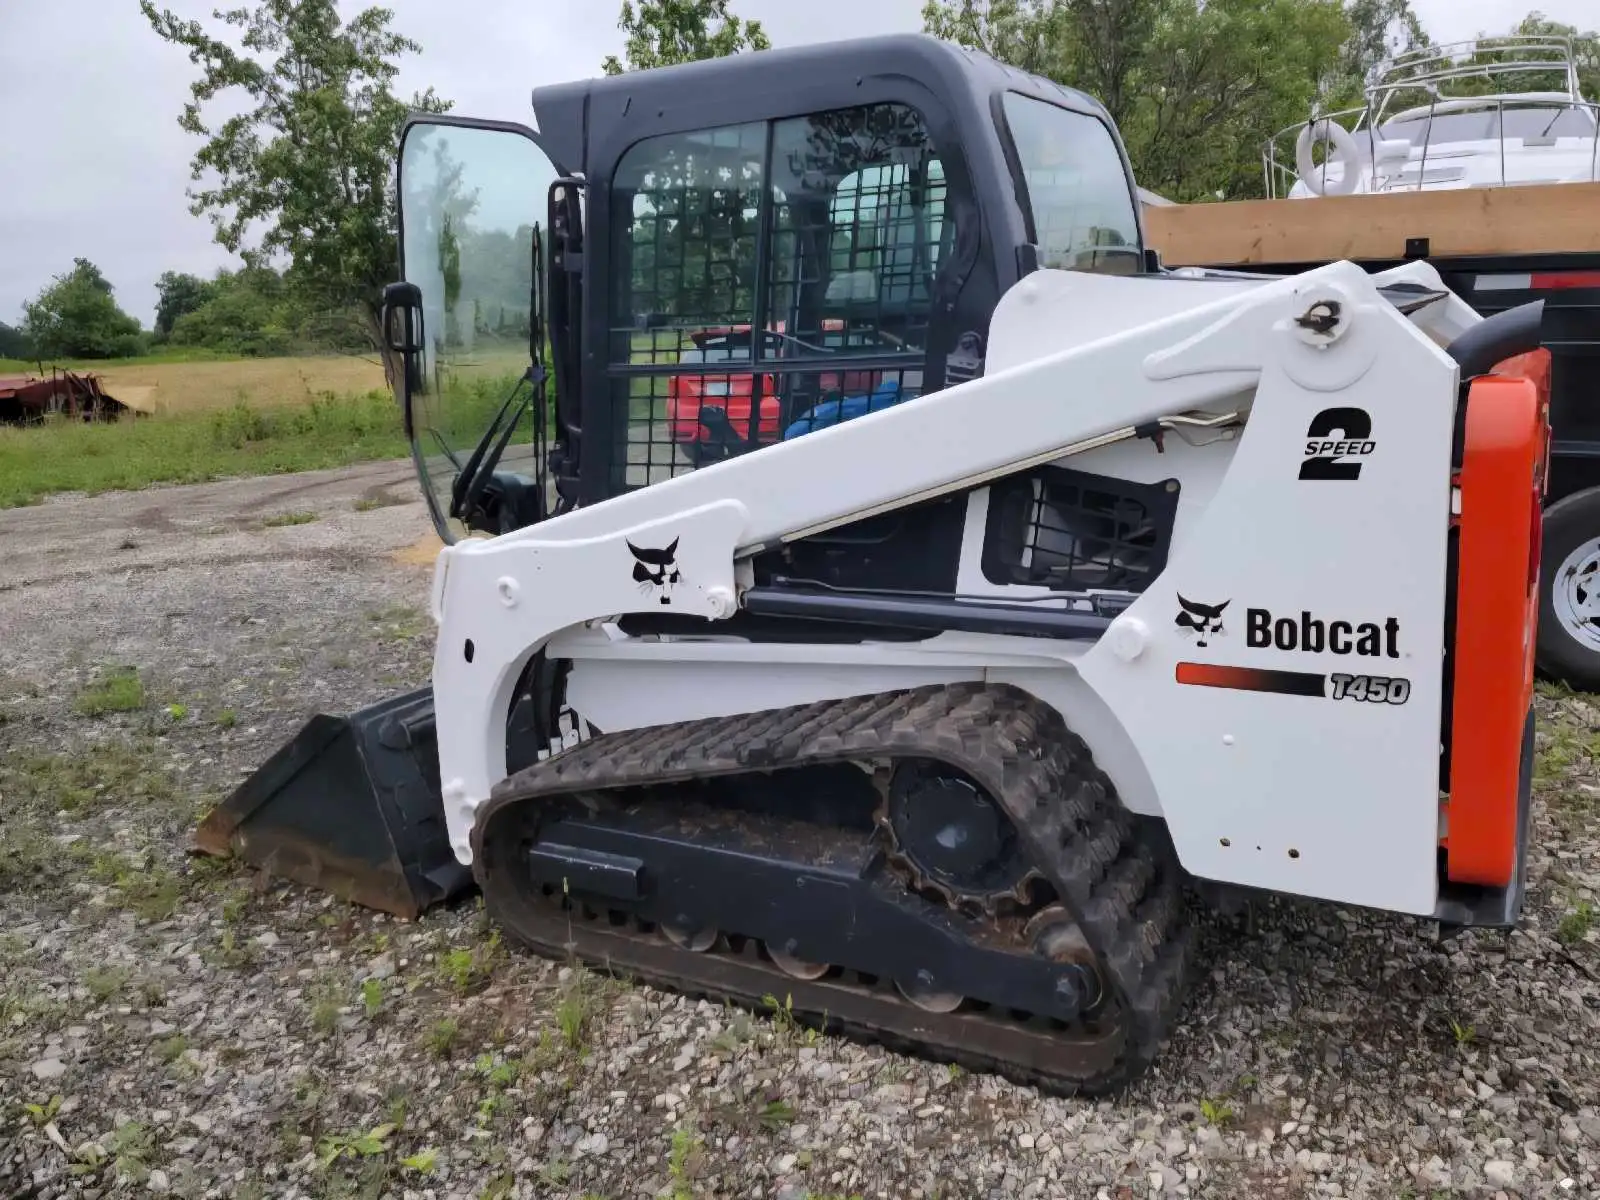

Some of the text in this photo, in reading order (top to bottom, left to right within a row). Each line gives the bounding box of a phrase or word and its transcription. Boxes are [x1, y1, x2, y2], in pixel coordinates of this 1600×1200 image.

[1298, 407, 1372, 480] 2
[1304, 441, 1376, 455] SPEED
[1246, 607, 1400, 658] Bobcat
[1331, 673, 1411, 705] T450
